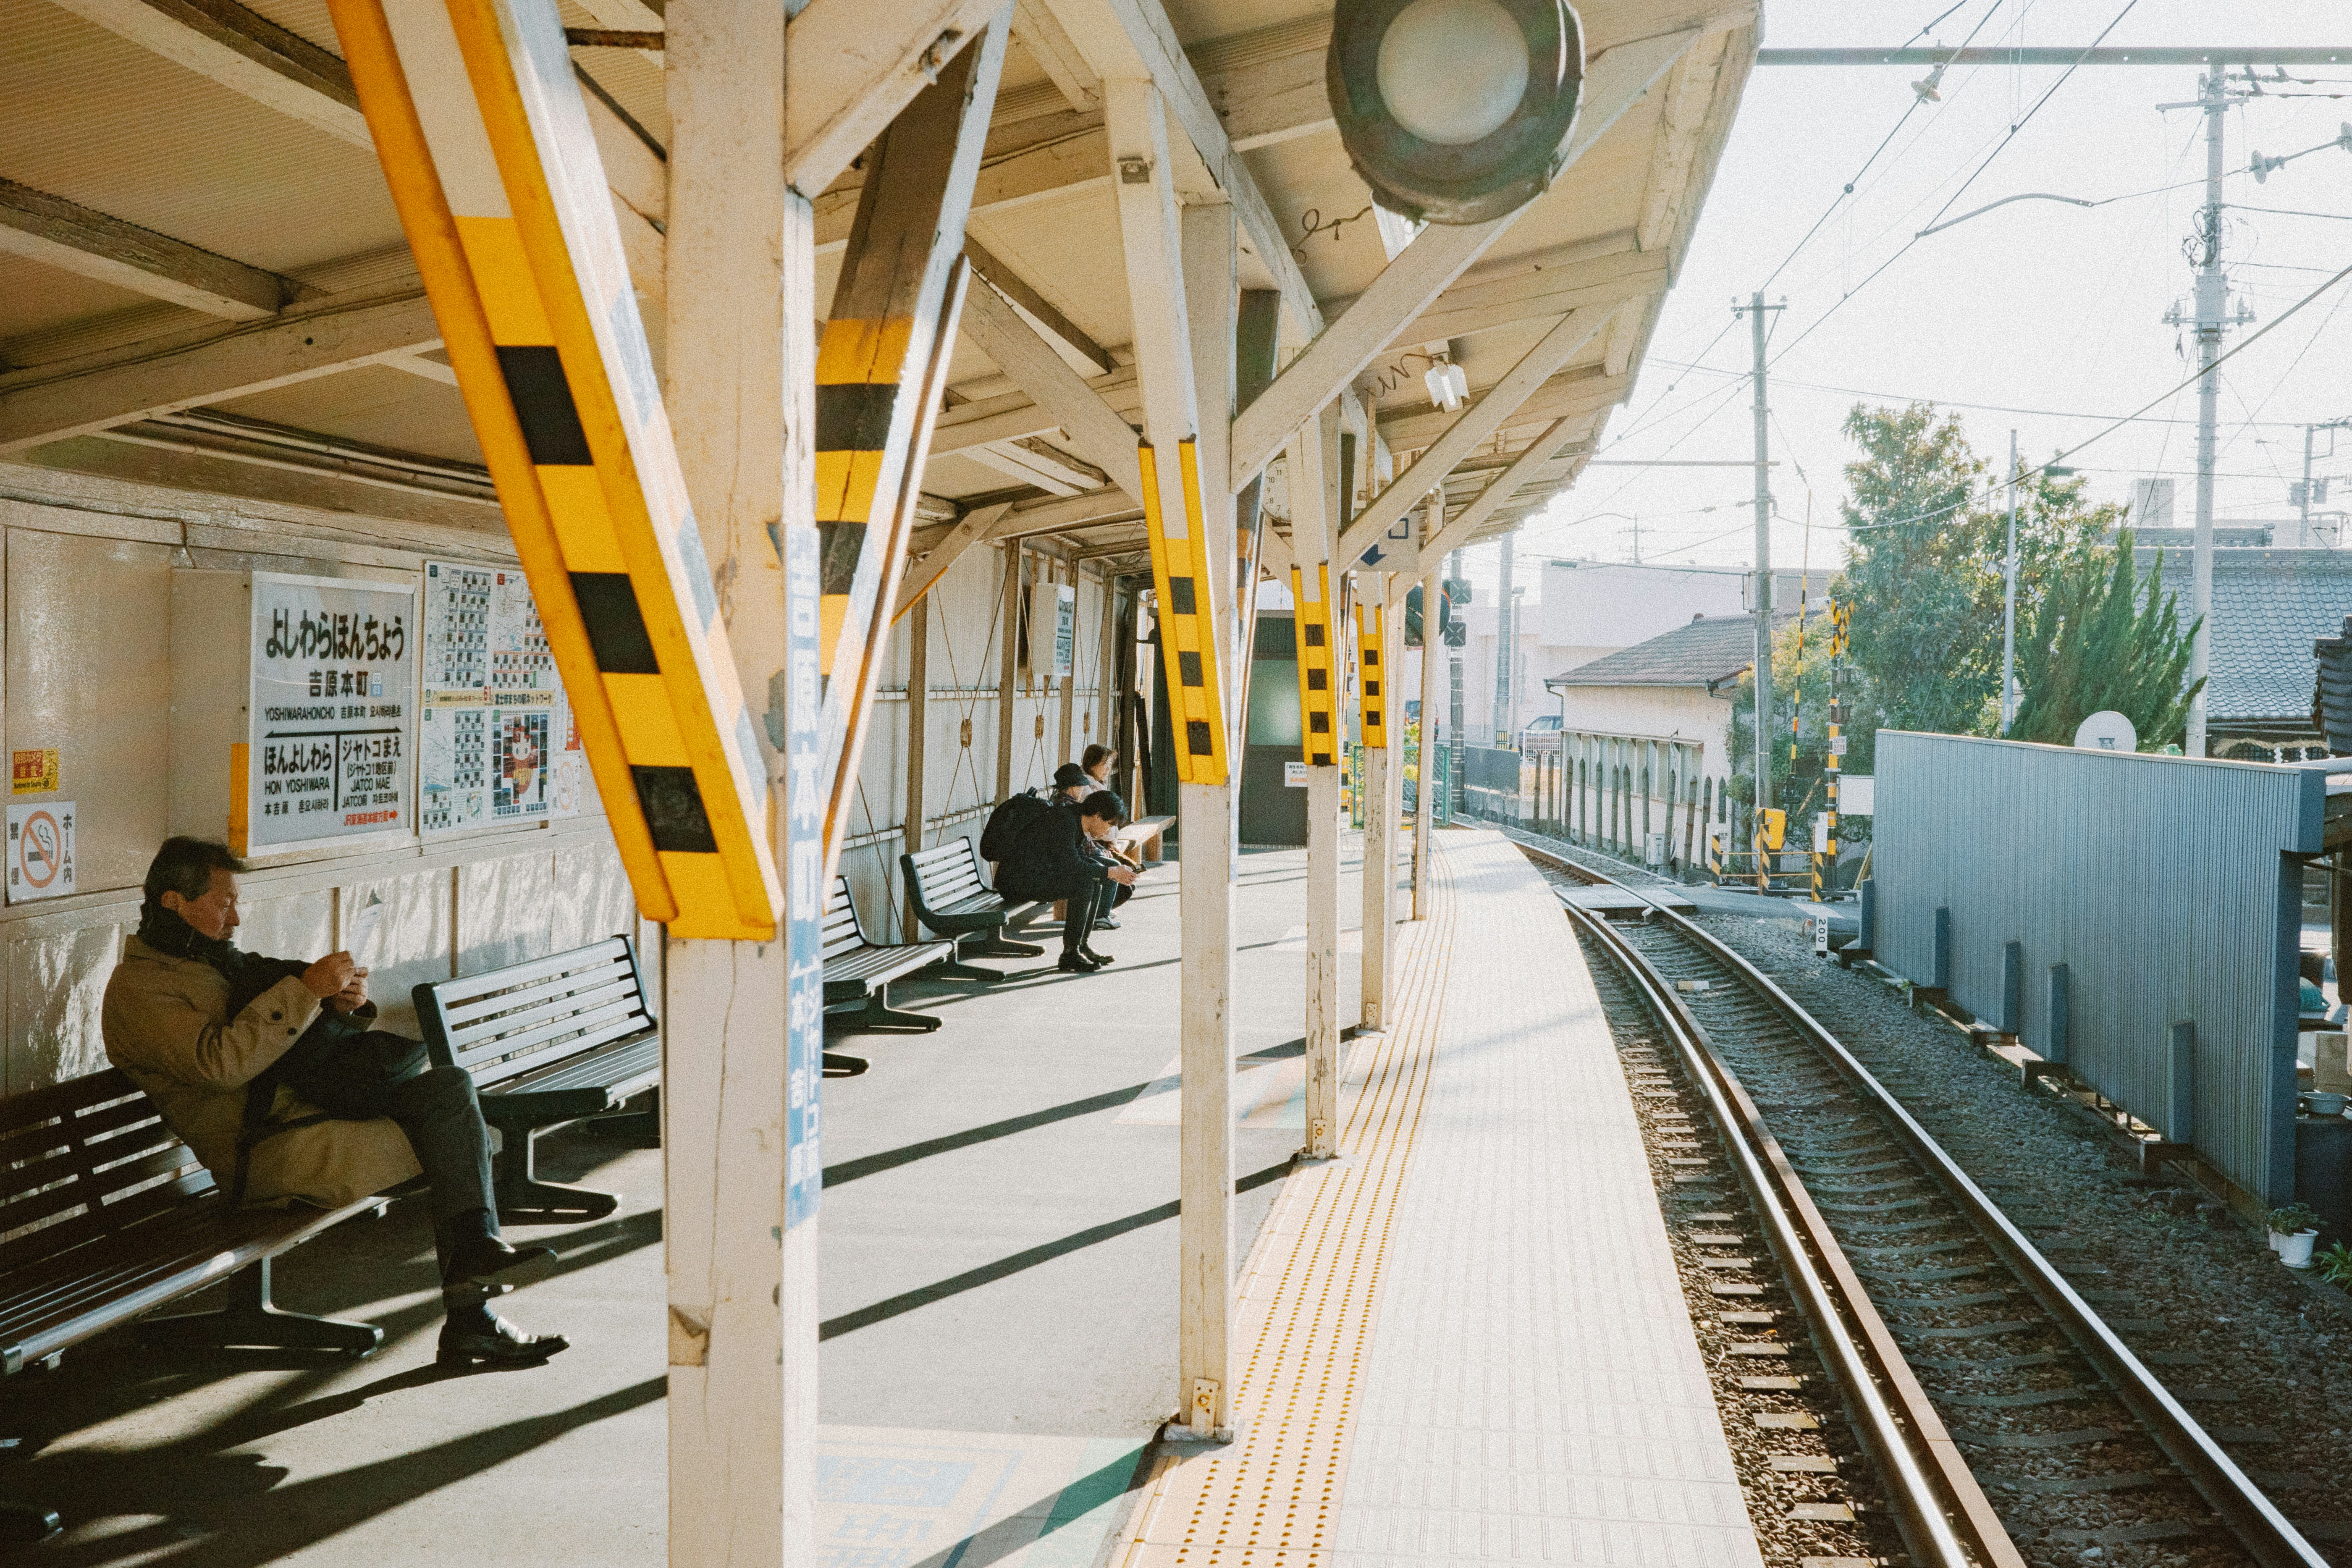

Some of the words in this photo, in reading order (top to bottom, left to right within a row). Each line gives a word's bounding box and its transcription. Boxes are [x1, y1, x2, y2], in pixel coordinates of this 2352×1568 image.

[266, 608, 404, 662] よしわらほんちょう
[309, 669, 370, 698] 吉原本町
[265, 706, 335, 721] YOSHIWARAHONCHO
[340, 705, 365, 719] 吉原本町
[792, 553, 817, 923] 吉原本町
[265, 743, 332, 775] ほんよしわら
[265, 779, 282, 795] HON
[286, 776, 330, 794] YOSHIWARA
[350, 777, 374, 792] JATCO
[375, 776, 391, 790] MAE
[264, 800, 289, 817] 本吉原
[62, 813, 72, 884] ホーム内
[1818, 918, 1827, 943] 200
